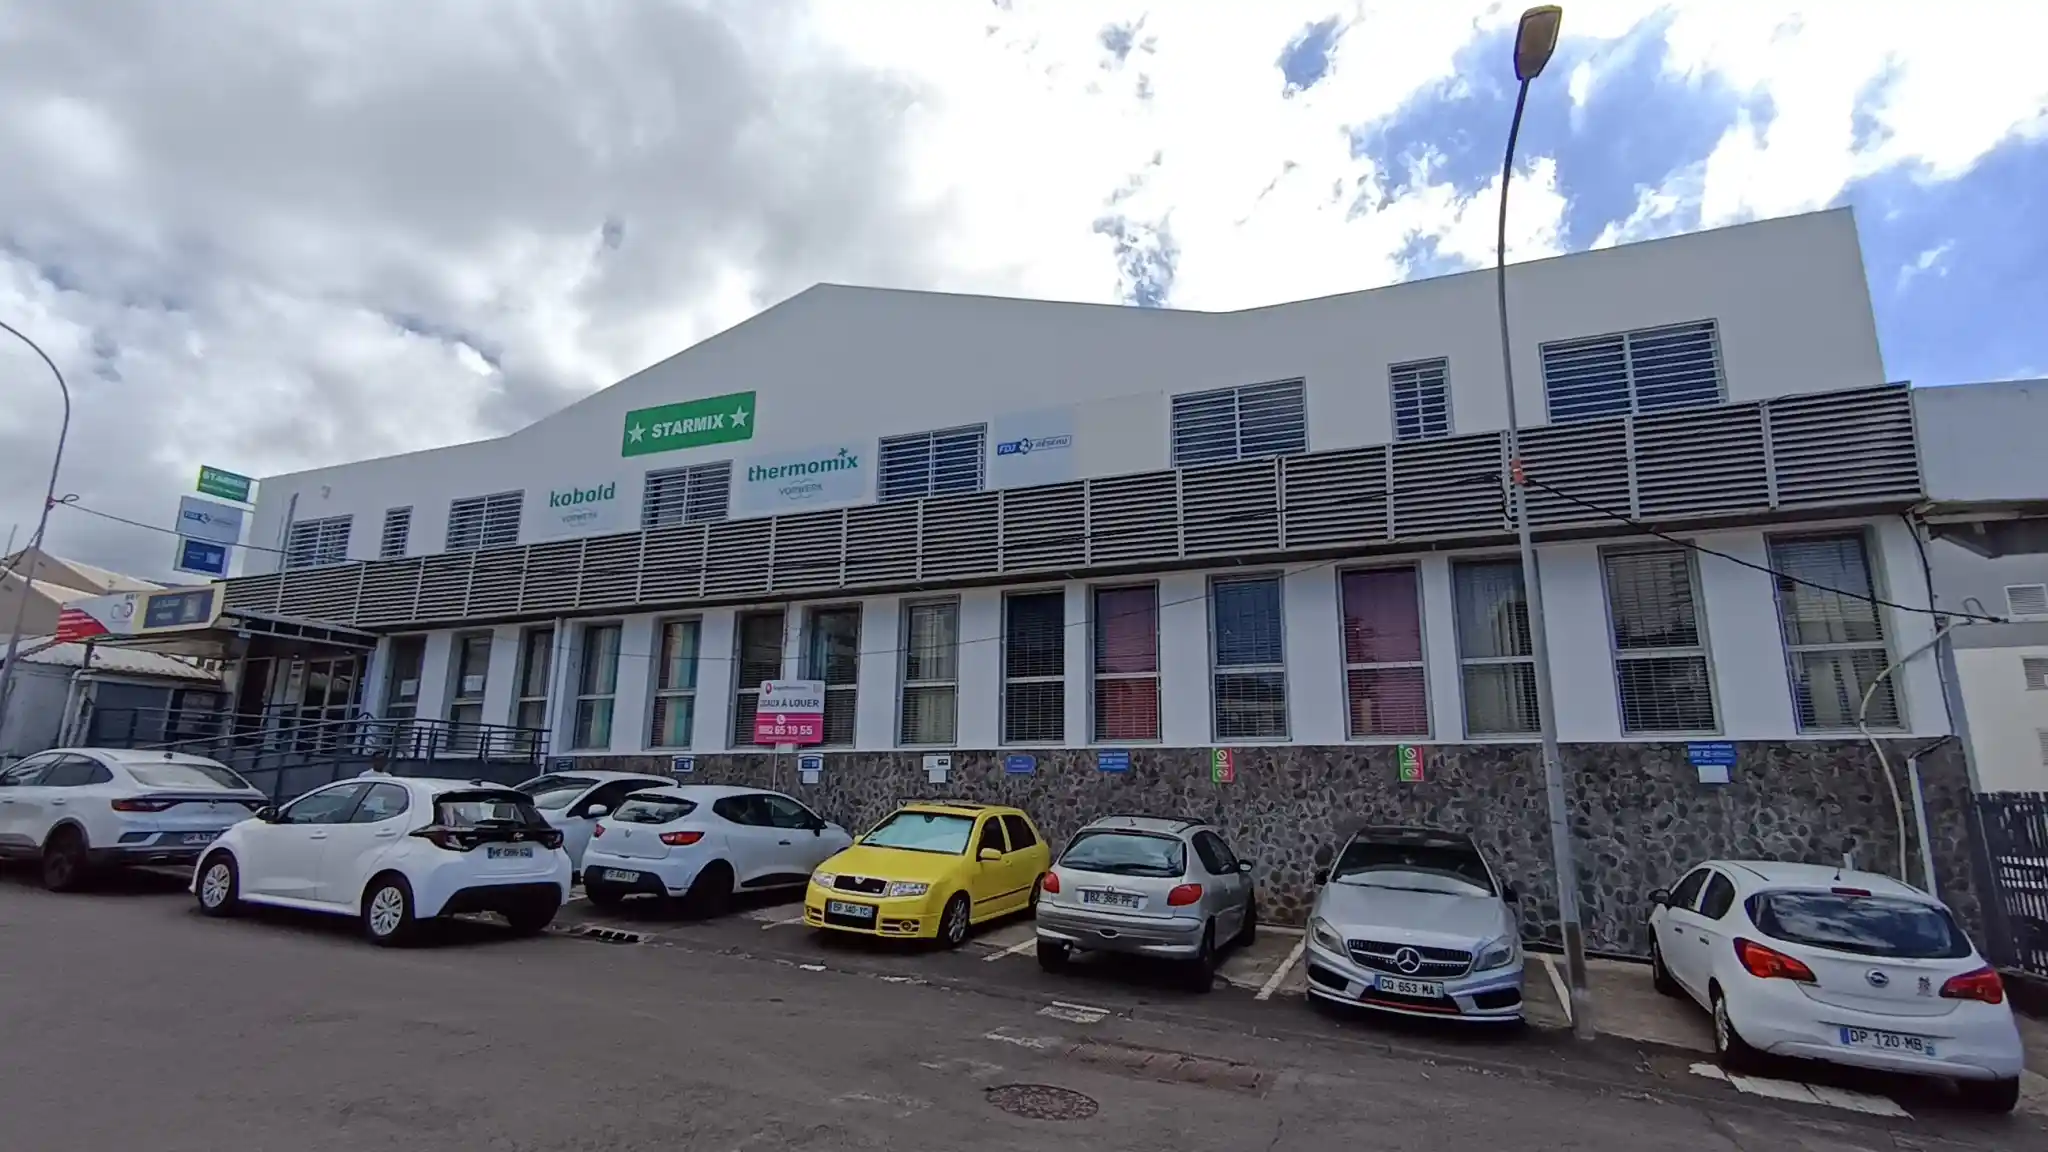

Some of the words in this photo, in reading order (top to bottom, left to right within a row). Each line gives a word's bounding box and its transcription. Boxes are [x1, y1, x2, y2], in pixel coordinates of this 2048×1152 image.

[651, 413, 724, 439] STARMIX
[747, 450, 858, 482] thermomix
[549, 481, 616, 508] kobold
[789, 698, 820, 708] LOUER
[787, 725, 798, 735] 19
[800, 725, 813, 735] 55
